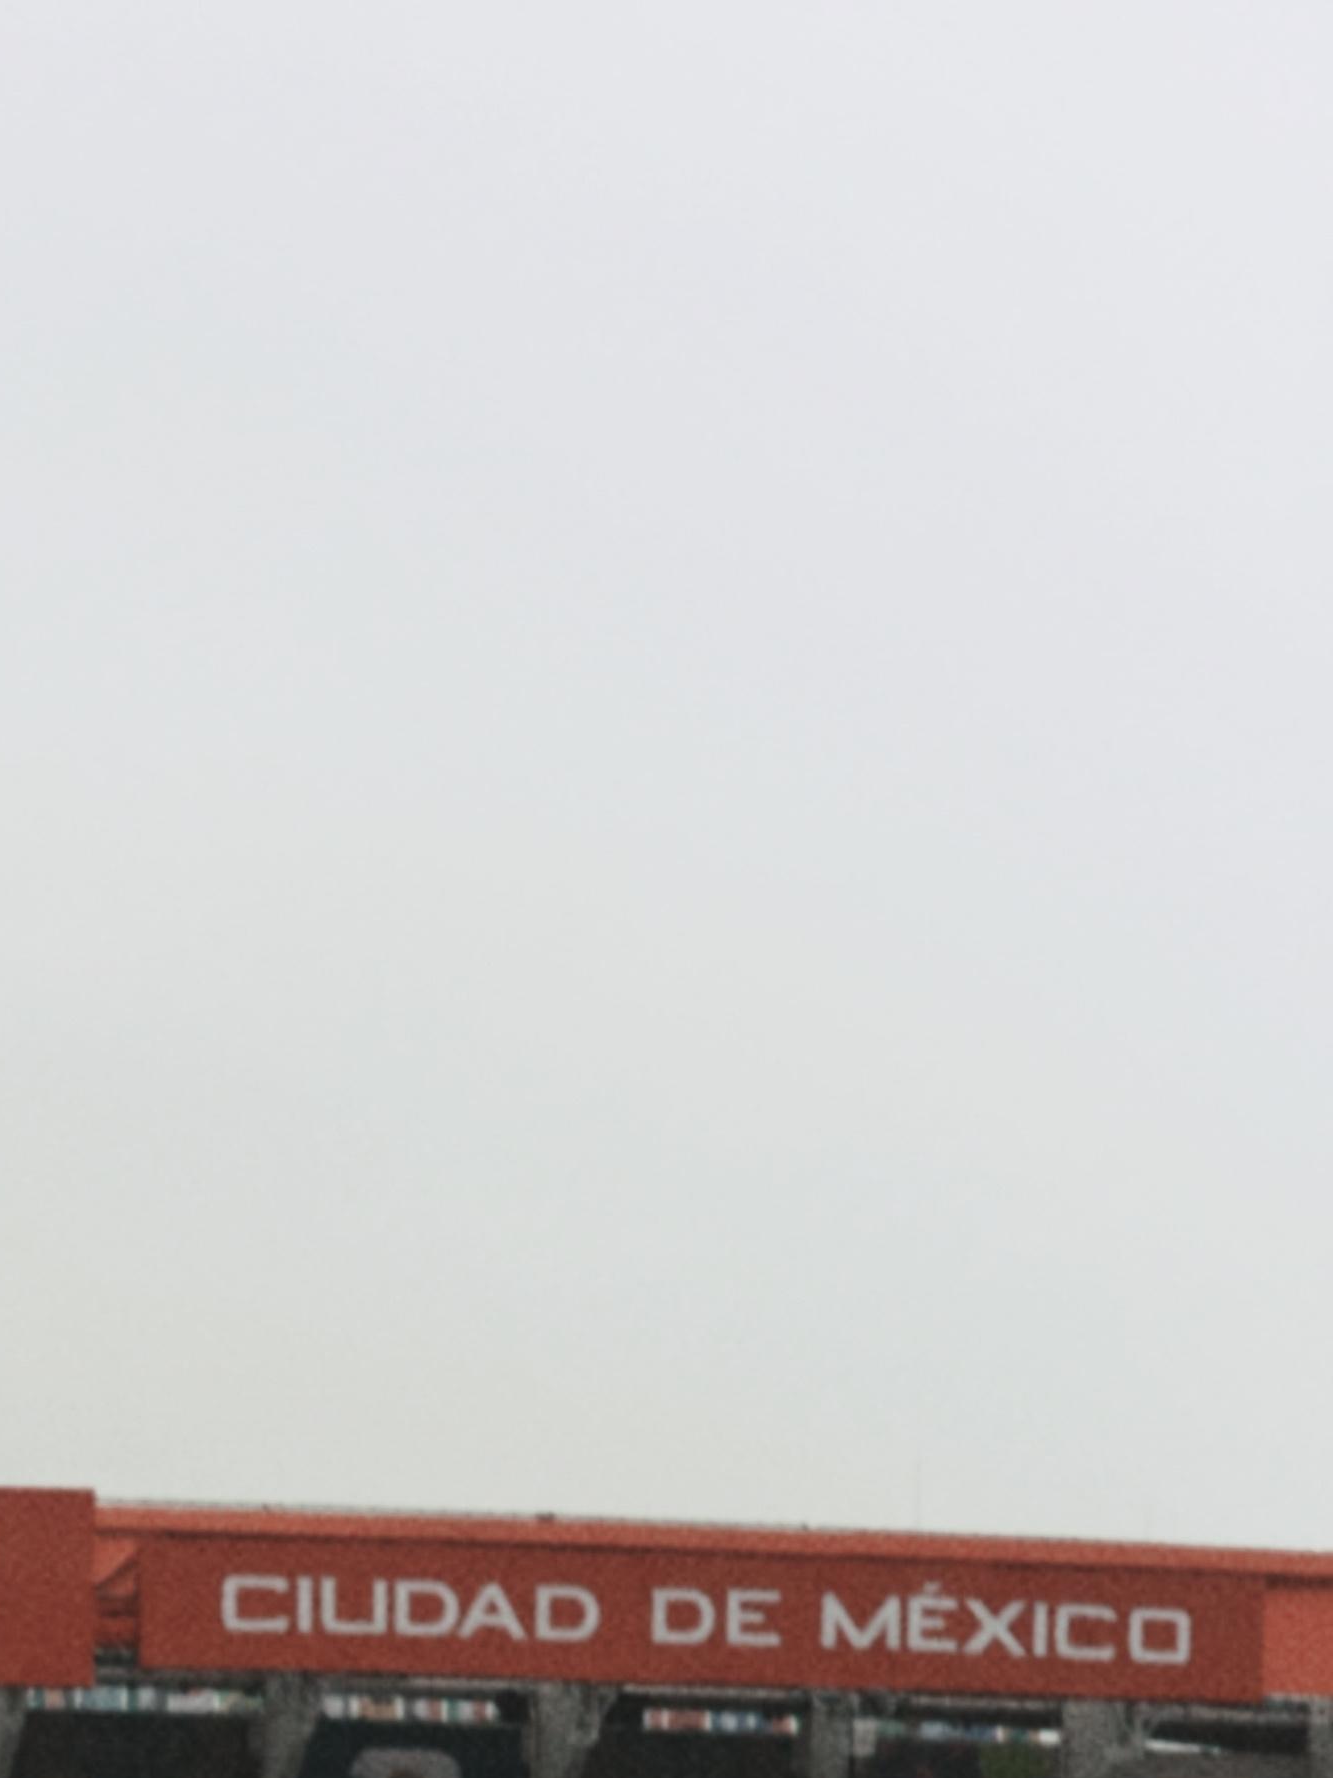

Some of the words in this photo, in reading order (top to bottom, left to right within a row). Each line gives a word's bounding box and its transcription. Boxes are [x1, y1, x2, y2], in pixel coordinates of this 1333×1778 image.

[222, 1574, 601, 1642] CIUDAD
[649, 1587, 782, 1647] DE
[820, 1581, 1191, 1665] MÉXICO
